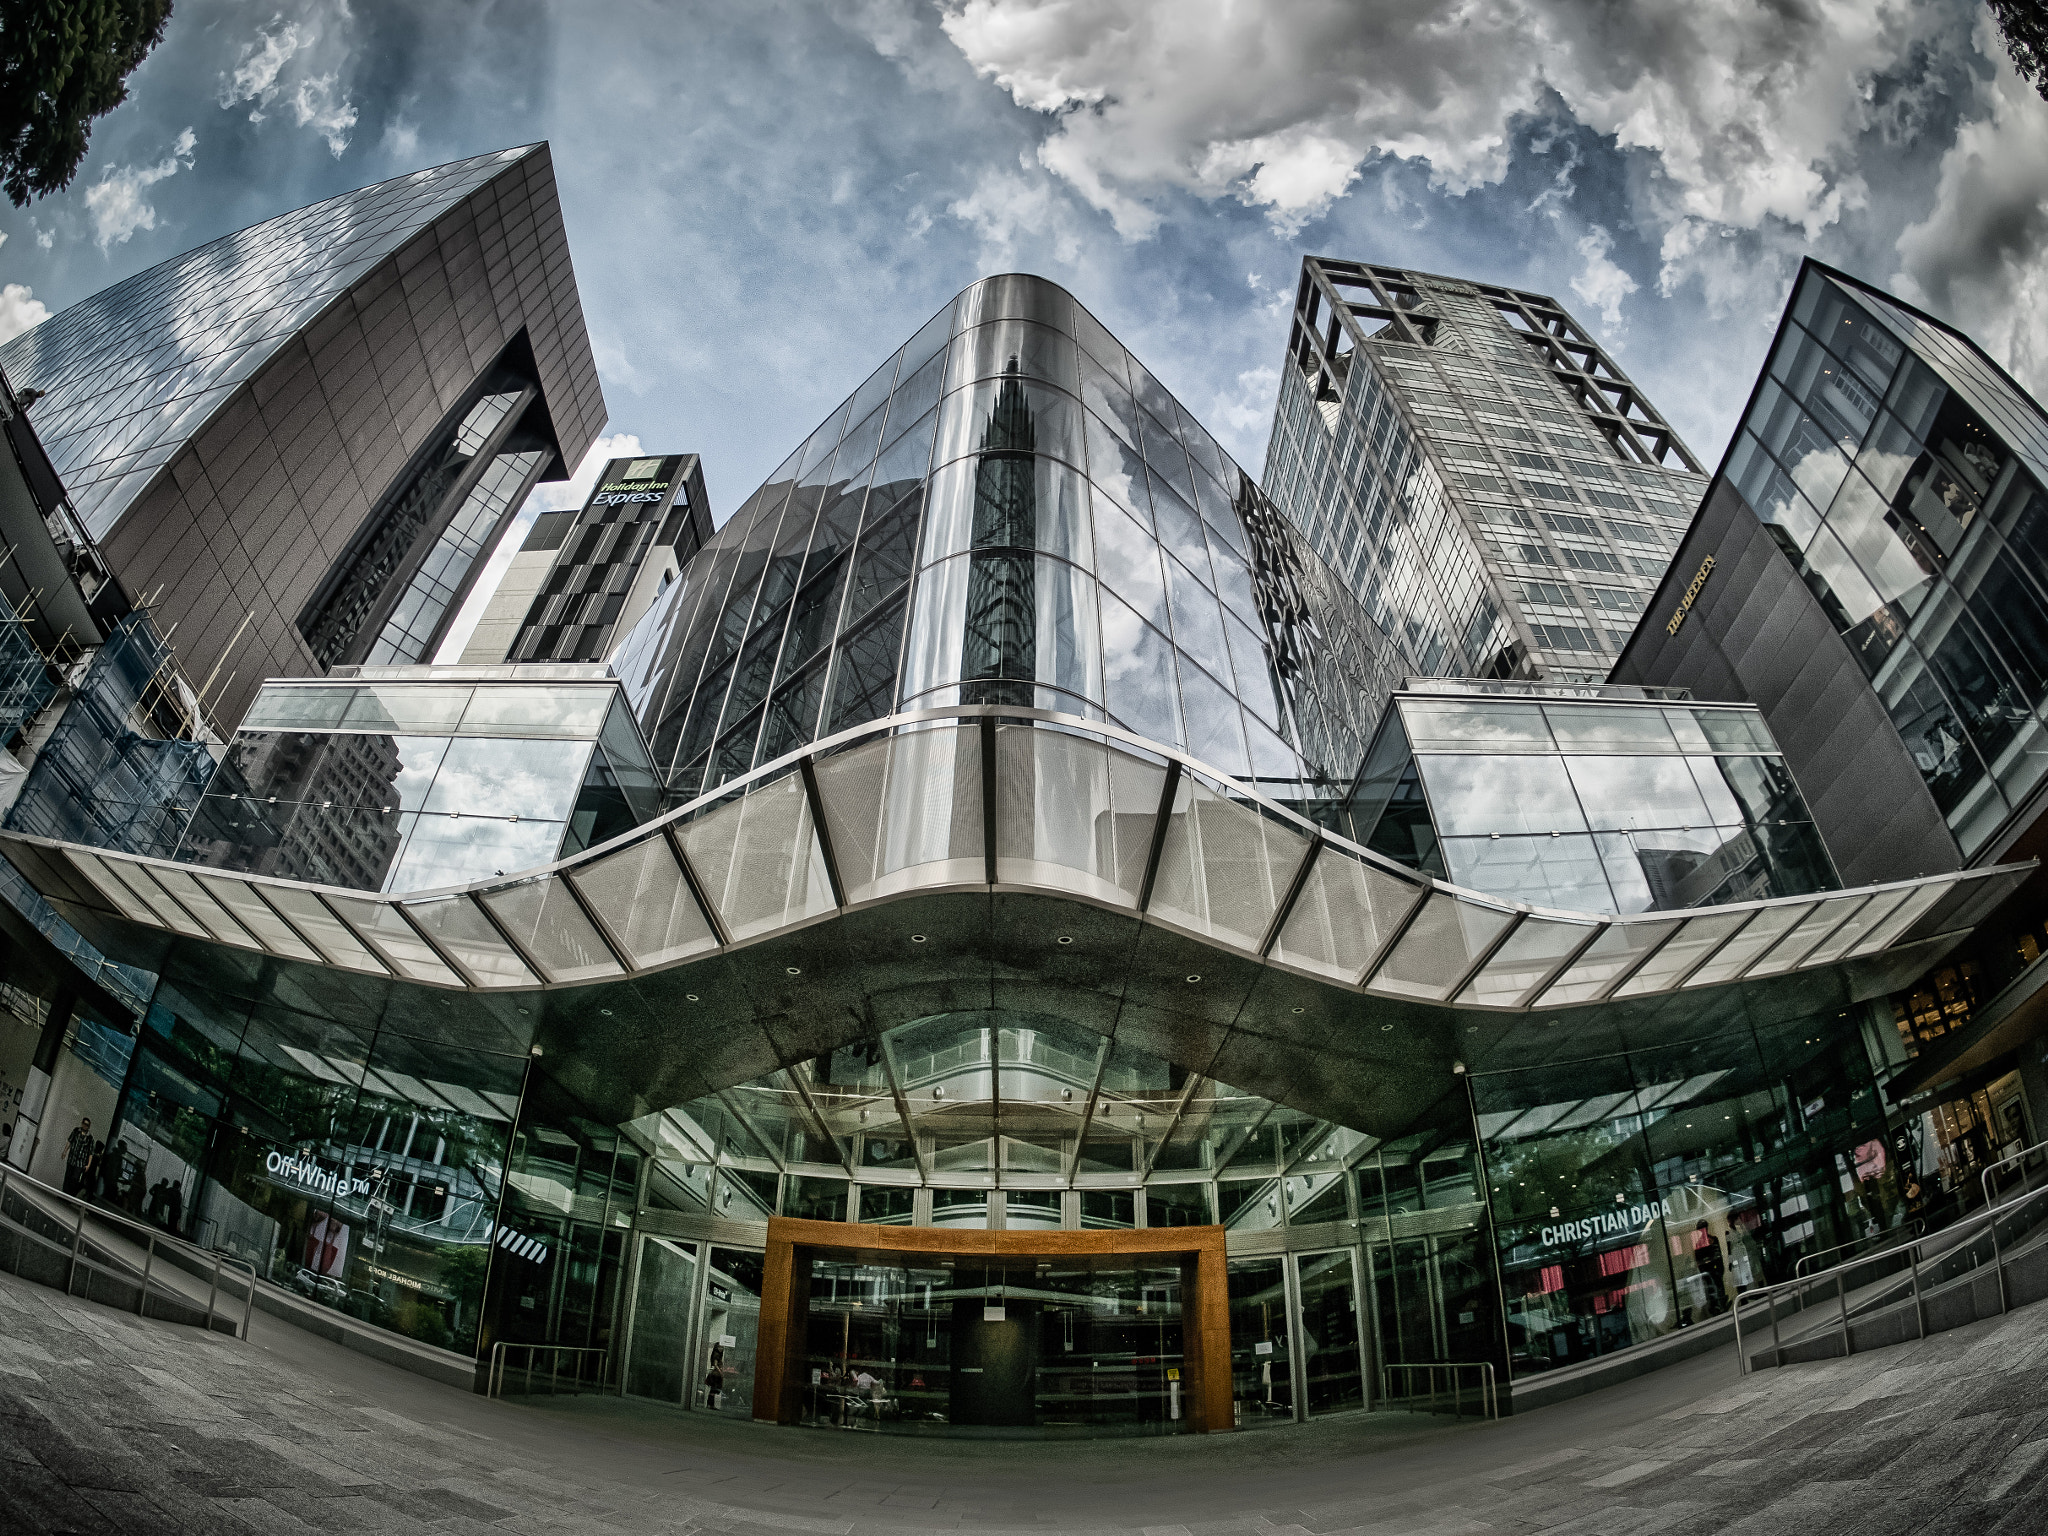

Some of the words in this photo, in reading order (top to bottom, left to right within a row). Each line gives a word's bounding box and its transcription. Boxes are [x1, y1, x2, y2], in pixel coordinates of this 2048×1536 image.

[592, 492, 665, 506] Express
[1666, 607, 1685, 636] THE
[1681, 554, 1717, 611] HEEREN
[1541, 1209, 1629, 1247] CHRISTIAN
[1630, 1199, 1672, 1225] DADA
